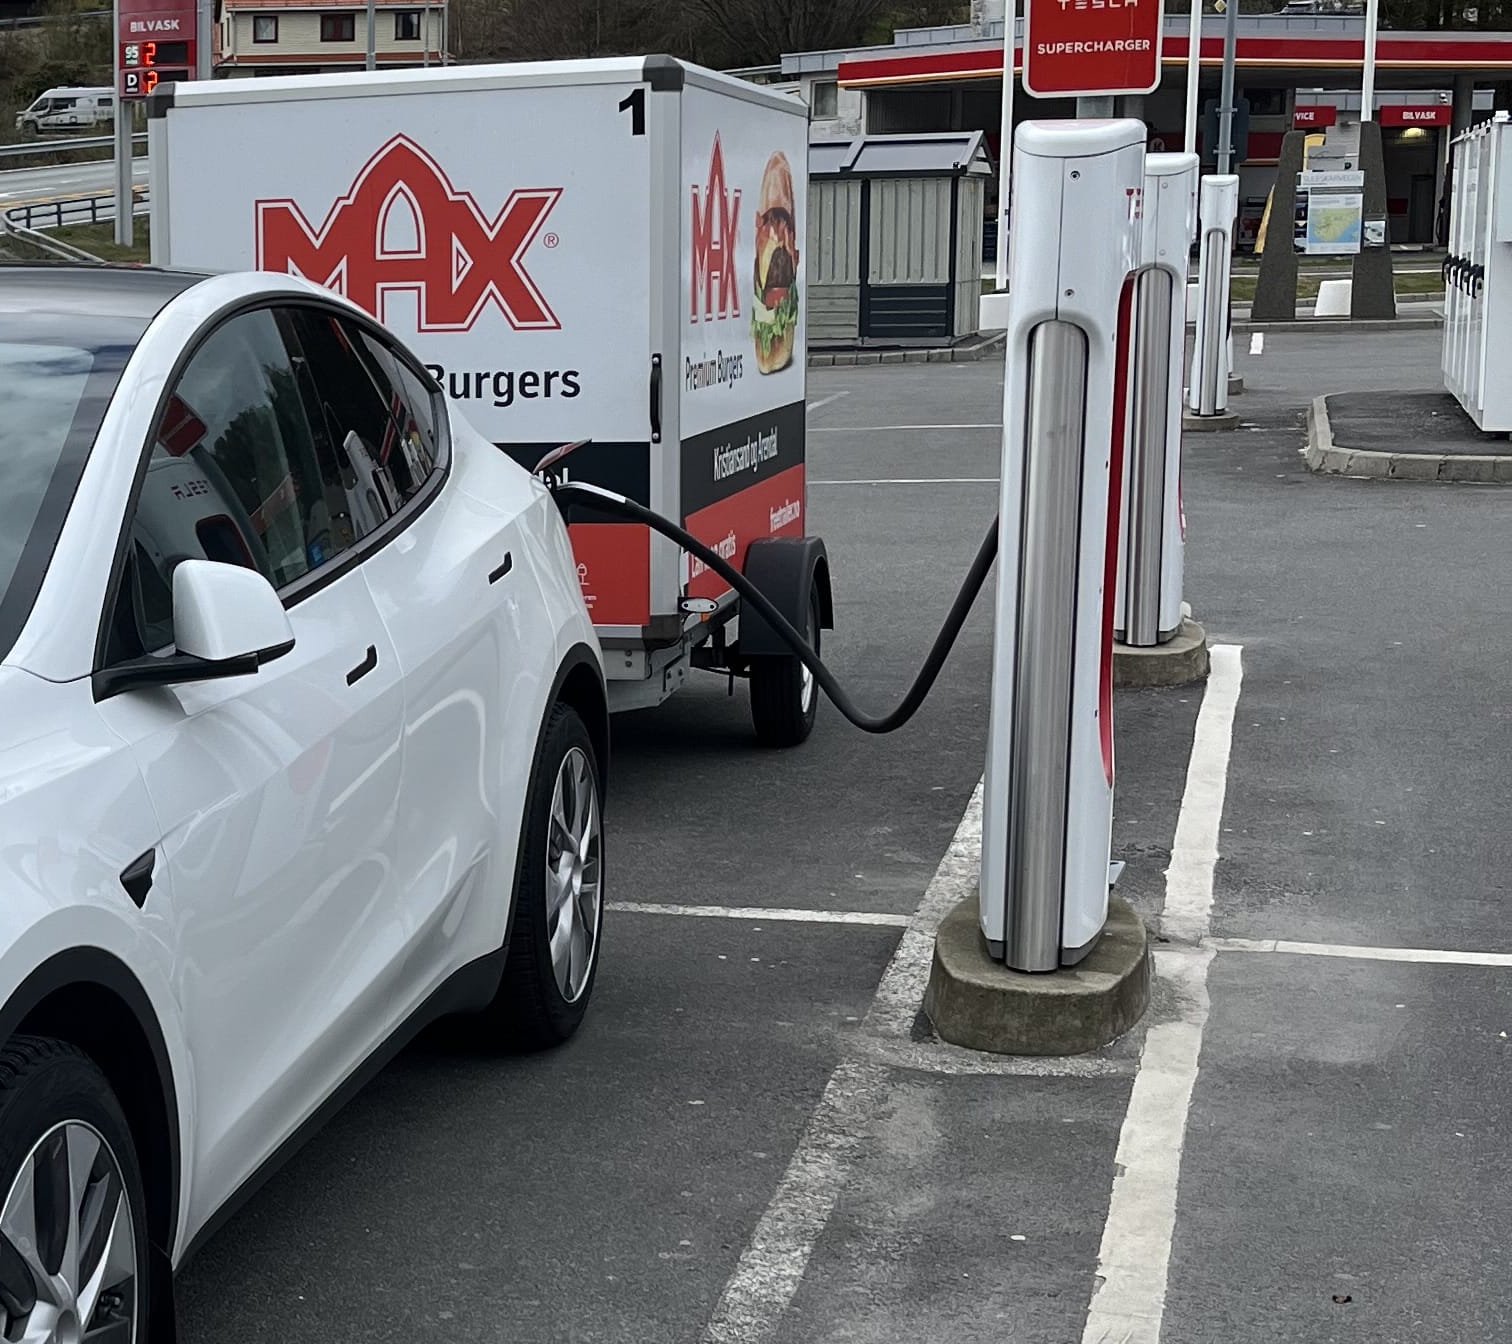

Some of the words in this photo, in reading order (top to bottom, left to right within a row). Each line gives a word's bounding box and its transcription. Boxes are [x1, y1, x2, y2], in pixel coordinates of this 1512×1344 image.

[130, 19, 180, 33] BILVASK
[1037, 39, 1151, 55] SUPERCHARGER
[128, 74, 138, 87] D
[618, 89, 646, 136] 1
[1294, 112, 1315, 121] VICE
[1402, 111, 1437, 120] BILVASK
[255, 132, 564, 333] MAX
[690, 128, 742, 324] MAX
[686, 352, 717, 392] Premium
[718, 350, 743, 389] Burgers
